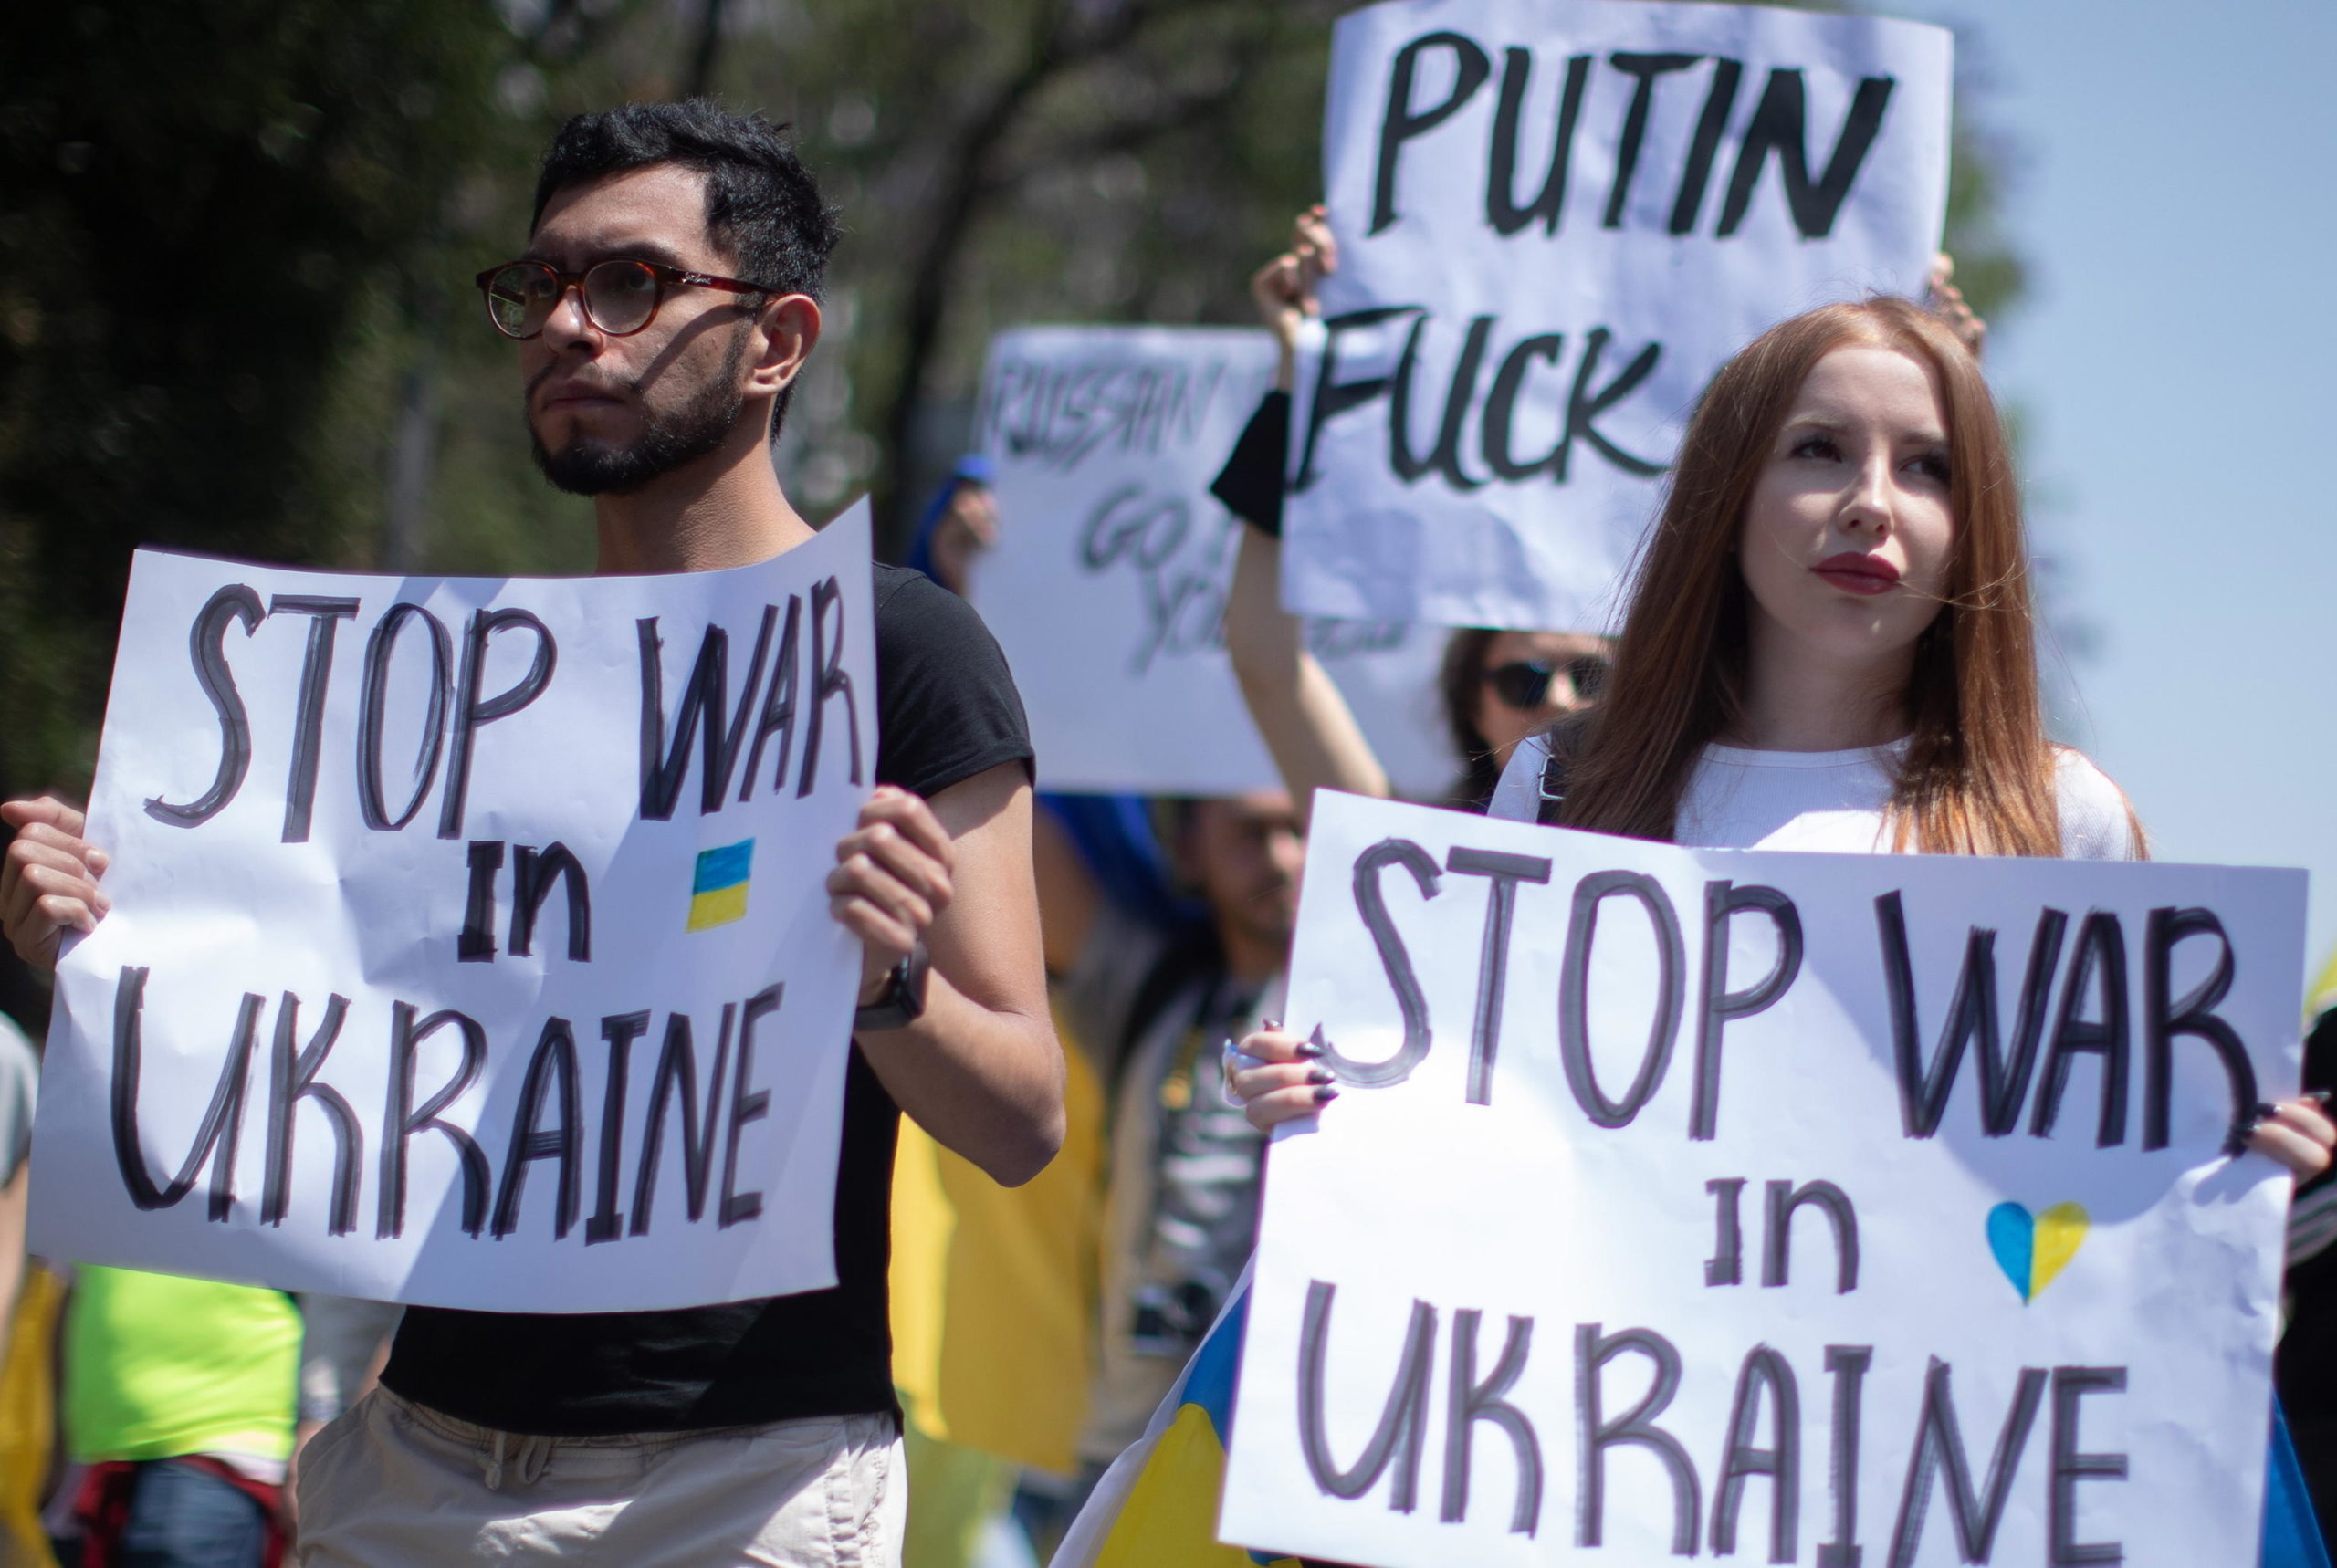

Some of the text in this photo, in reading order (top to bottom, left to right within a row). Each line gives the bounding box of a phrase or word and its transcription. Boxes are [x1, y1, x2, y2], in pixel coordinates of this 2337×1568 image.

[1366, 31, 1897, 241] PUTIN
[1283, 305, 1672, 489] FUCK
[143, 575, 864, 844] STOP WAR
[110, 965, 785, 1246] UKRAINE
[1312, 837, 2264, 1159] STOP WAR
[1296, 1280, 2129, 1567] UKRAINE
